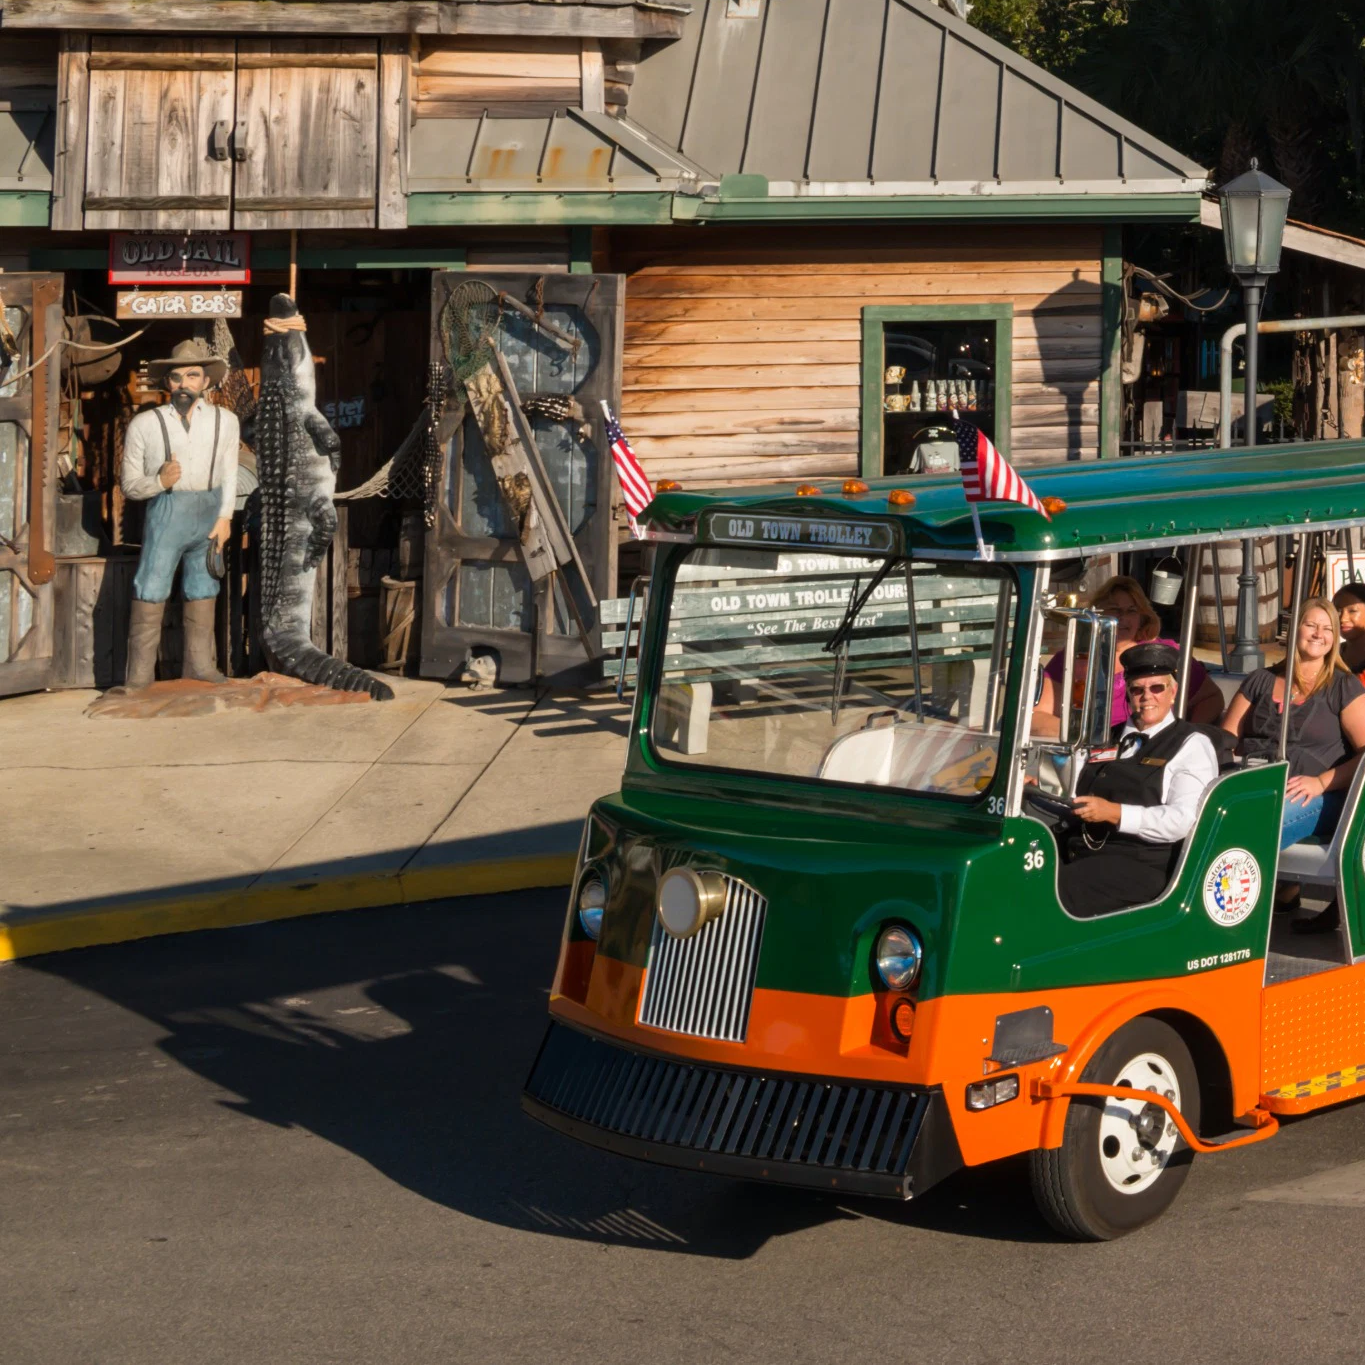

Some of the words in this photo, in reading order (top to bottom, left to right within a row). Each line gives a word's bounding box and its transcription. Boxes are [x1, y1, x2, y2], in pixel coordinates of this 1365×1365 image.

[122, 239, 174, 265] OLD
[178, 239, 240, 267] JAIL
[145, 264, 221, 277] MUSEUM
[131, 296, 187, 314] GATOR
[190, 293, 237, 315] BOB'S
[728, 519, 755, 538] OLD
[761, 521, 802, 542] TOWN
[809, 524, 873, 546] TROLLEY
[798, 557, 840, 573] TOWN
[711, 596, 741, 612] OLD
[746, 592, 791, 609] TOWN
[784, 619, 806, 633] The
[812, 616, 841, 630] Best
[847, 612, 884, 628] irst”
[987, 795, 1005, 816] 36
[1023, 849, 1045, 872] 36
[1206, 858, 1228, 893] Historic
[1187, 958, 1200, 971] US
[1200, 954, 1219, 969] DOT
[1219, 948, 1251, 965] 1281776
